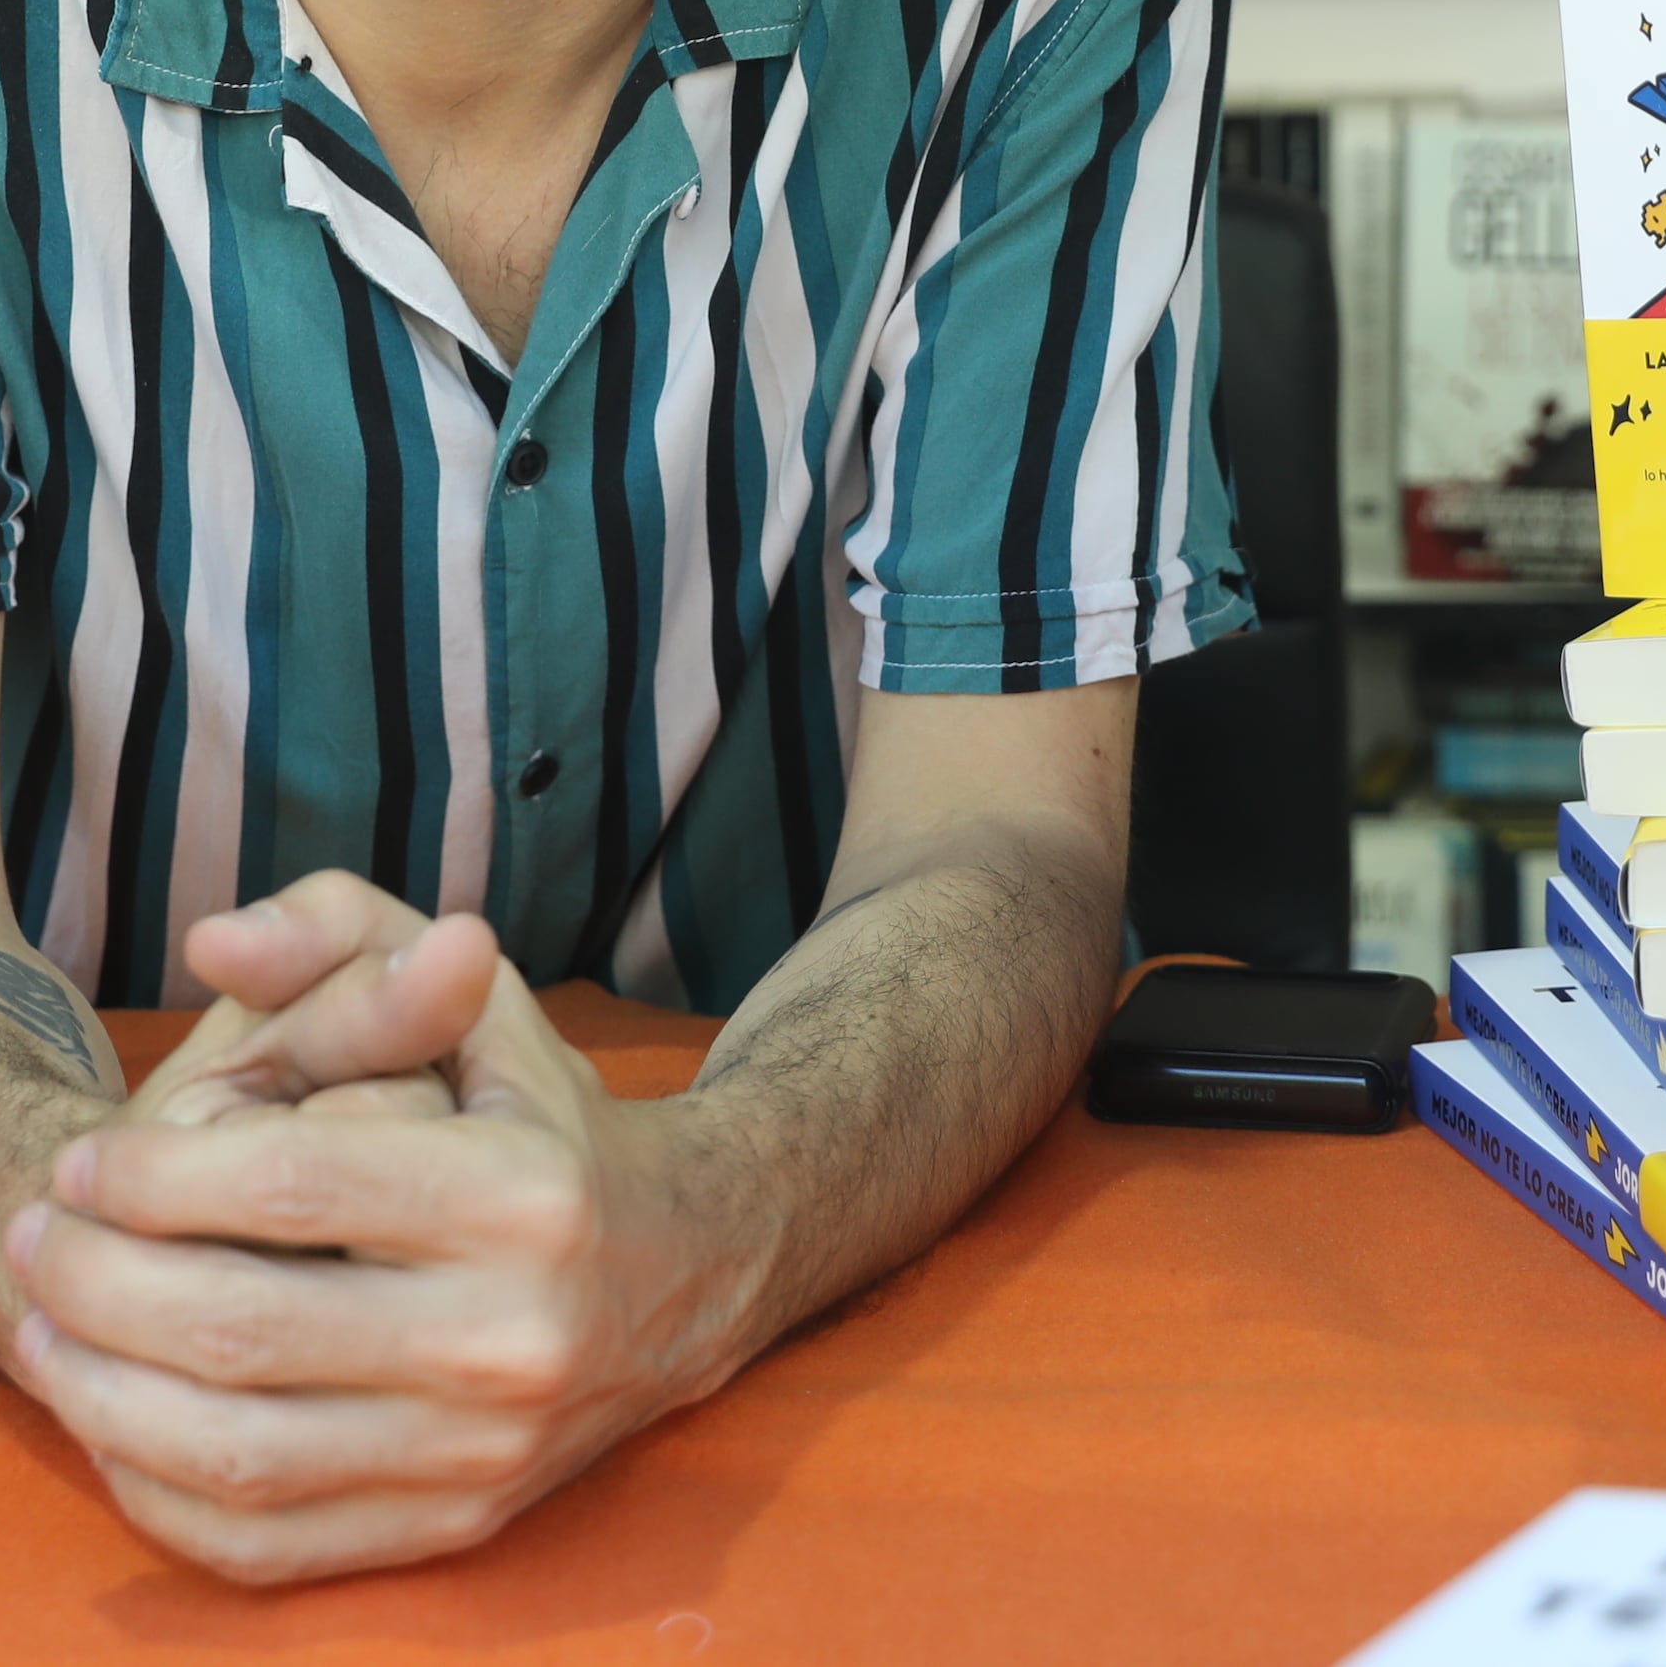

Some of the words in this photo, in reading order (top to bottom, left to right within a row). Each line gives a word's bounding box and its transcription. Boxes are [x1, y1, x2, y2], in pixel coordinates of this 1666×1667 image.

[1644, 469, 1656, 482] lo
[1570, 845, 1597, 892] MEJOR
[1622, 998, 1651, 1053] CREAS
[1192, 1085, 1276, 1103] SAMSUNG
[1464, 1000, 1497, 1051] MEJOR
[1499, 1034, 1514, 1069] NO
[1515, 1047, 1527, 1082] TE
[1529, 1067, 1542, 1099] LO
[1545, 1082, 1579, 1139] CREAS
[1431, 1091, 1477, 1146] MEJOR
[1481, 1131, 1501, 1164] NO
[1505, 1149, 1520, 1181] TE
[1524, 1162, 1542, 1197] LO
[1546, 1181, 1595, 1240] CREAS
